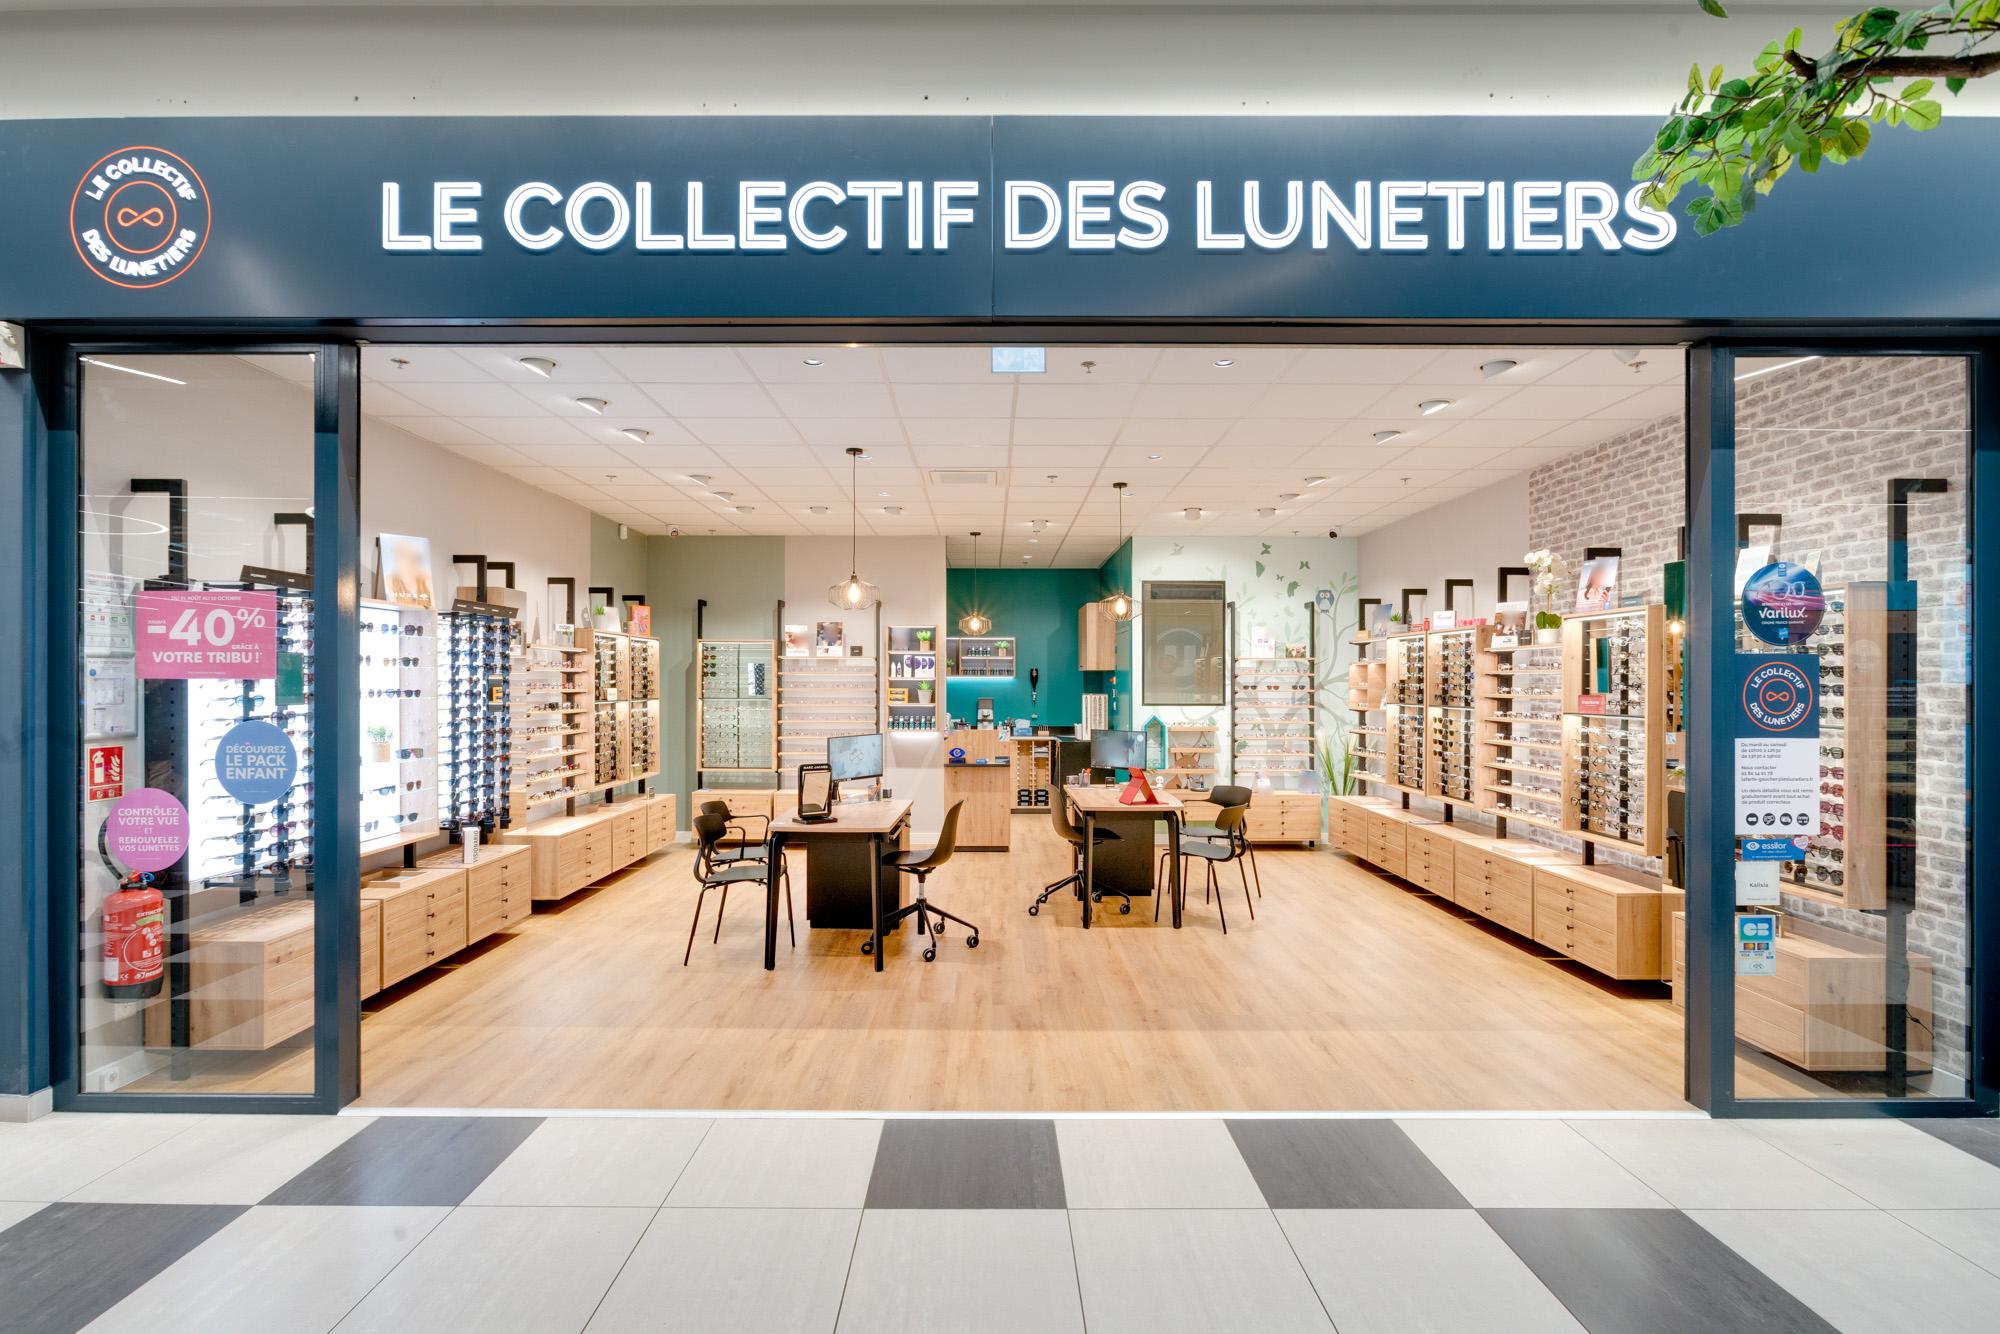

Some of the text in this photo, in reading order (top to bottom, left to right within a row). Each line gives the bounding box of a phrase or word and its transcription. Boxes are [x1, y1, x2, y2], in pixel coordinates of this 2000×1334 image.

[85, 157, 197, 201] LE COLLECTIF
[381, 180, 1679, 251] LE COLLECTIF DES LUNETIERS
[82, 228, 197, 276] DES LUNETIERS
[152, 651, 203, 664] VOTRE
[206, 651, 252, 664] TRIBU
[1751, 667, 1805, 689] LE COLLECTIF
[1750, 702, 1805, 725] DES LUNETIERS
[225, 743, 287, 753] DÉCOUVREZ
[226, 754, 287, 767] LE PACK
[226, 767, 287, 780] ENFANT
[118, 805, 179, 816] CONTRÔLEZ
[118, 816, 179, 826] VOTRE VUE
[144, 827, 153, 835] ET
[118, 836, 180, 844] RENOUVELEZ
[1761, 842, 1787, 850] essilor
[118, 844, 180, 852] VOS LUNETTES
